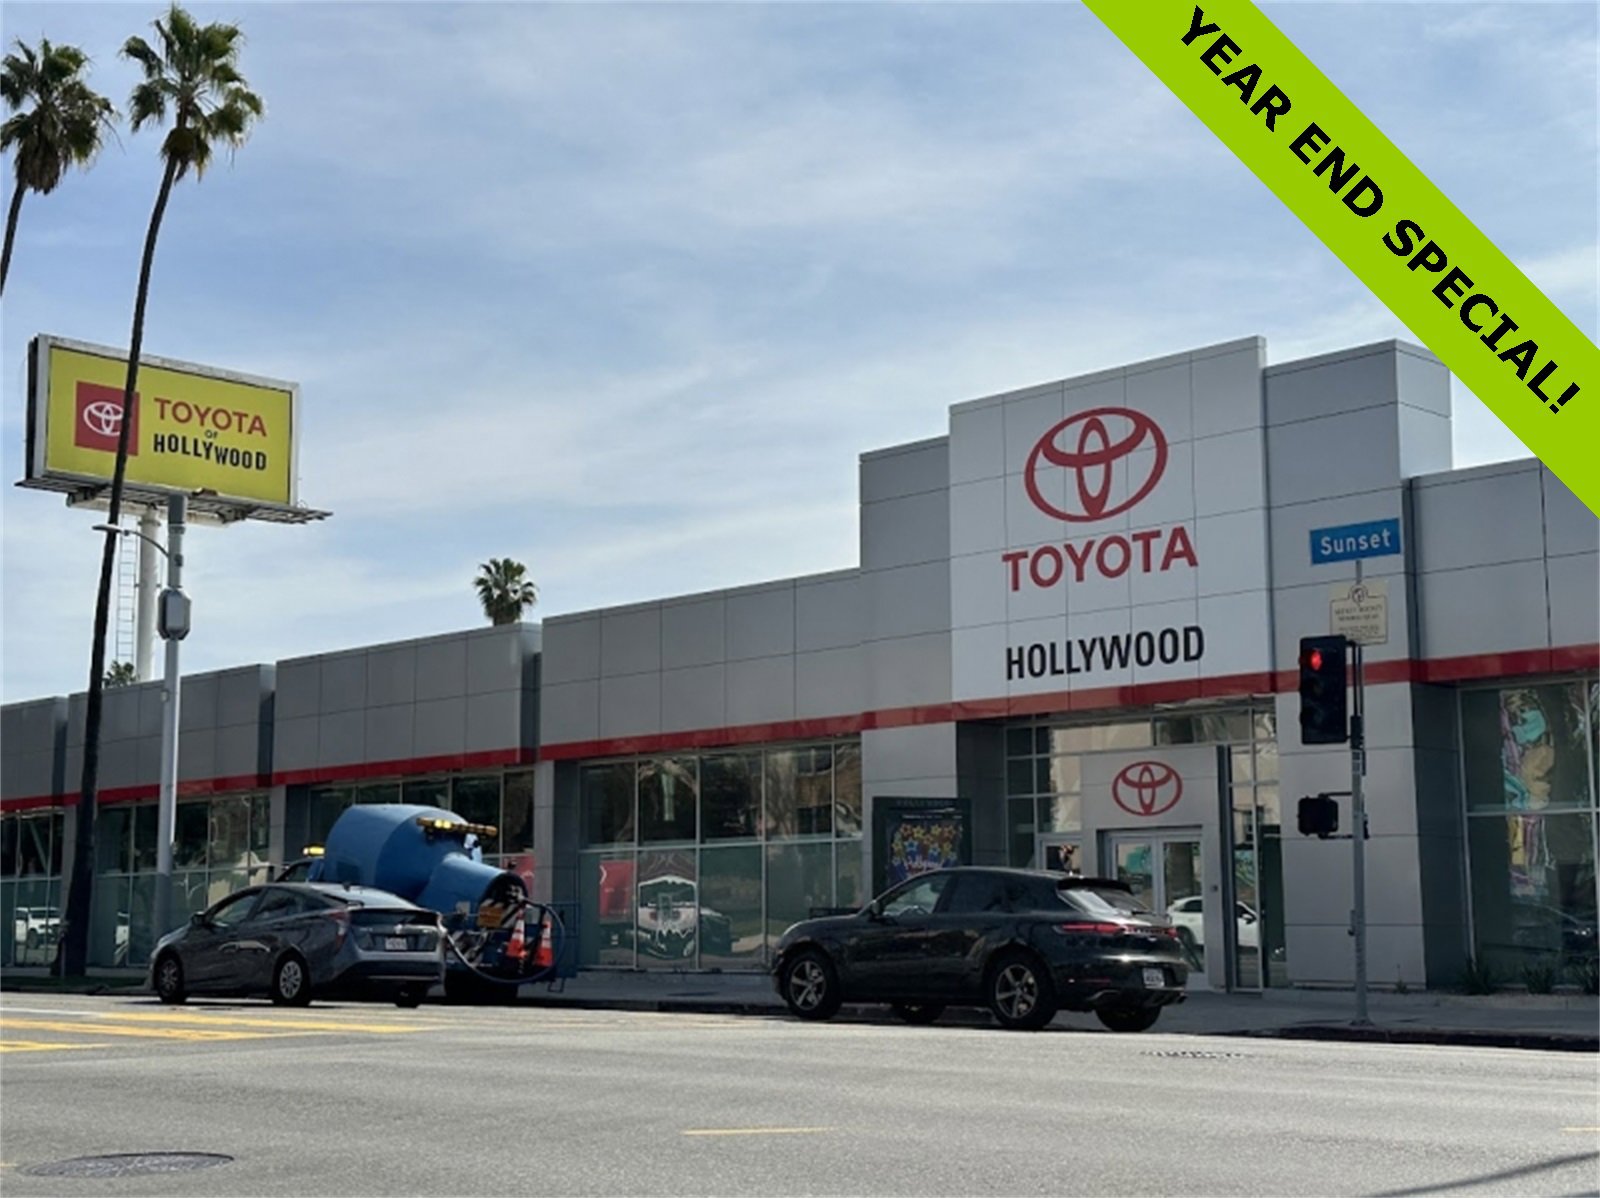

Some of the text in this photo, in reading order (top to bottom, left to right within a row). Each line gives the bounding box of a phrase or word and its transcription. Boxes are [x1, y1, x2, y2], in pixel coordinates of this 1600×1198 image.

[154, 397, 267, 437] TOYOTA
[153, 433, 267, 471] HOLLYWOOD
[1002, 526, 1198, 592] TOYOTA
[1320, 527, 1391, 555] Sunset
[1006, 625, 1205, 680] HOLLYWOOD
